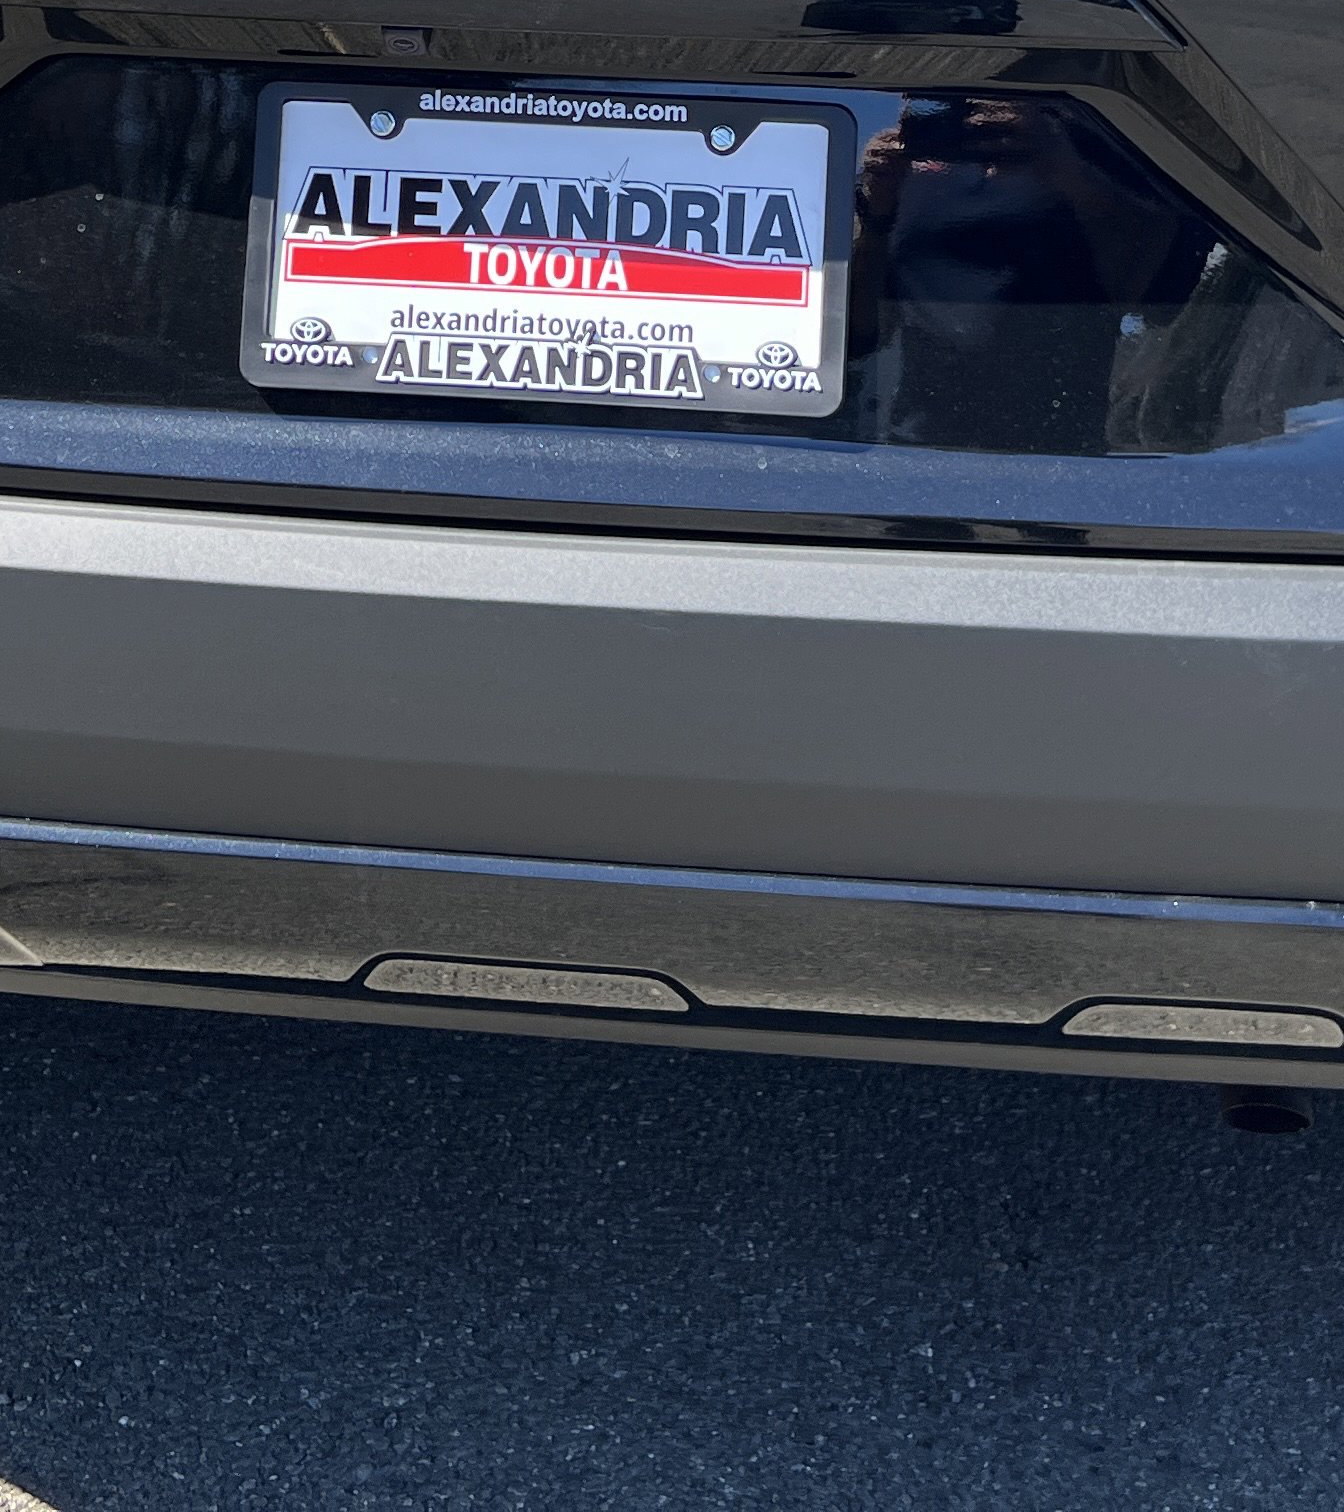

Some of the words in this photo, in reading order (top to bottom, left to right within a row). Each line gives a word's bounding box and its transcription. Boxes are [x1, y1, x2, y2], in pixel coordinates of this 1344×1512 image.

[419, 89, 689, 123] alexandriatoyota.com
[289, 172, 805, 262] ALEXANDRIA
[463, 242, 629, 293] TOYOTA
[390, 303, 695, 343] alexandriatoyota.com
[259, 342, 355, 367] TOYOTA
[378, 336, 701, 397] ALEXANDRIA
[727, 366, 824, 394] TOYOTA
